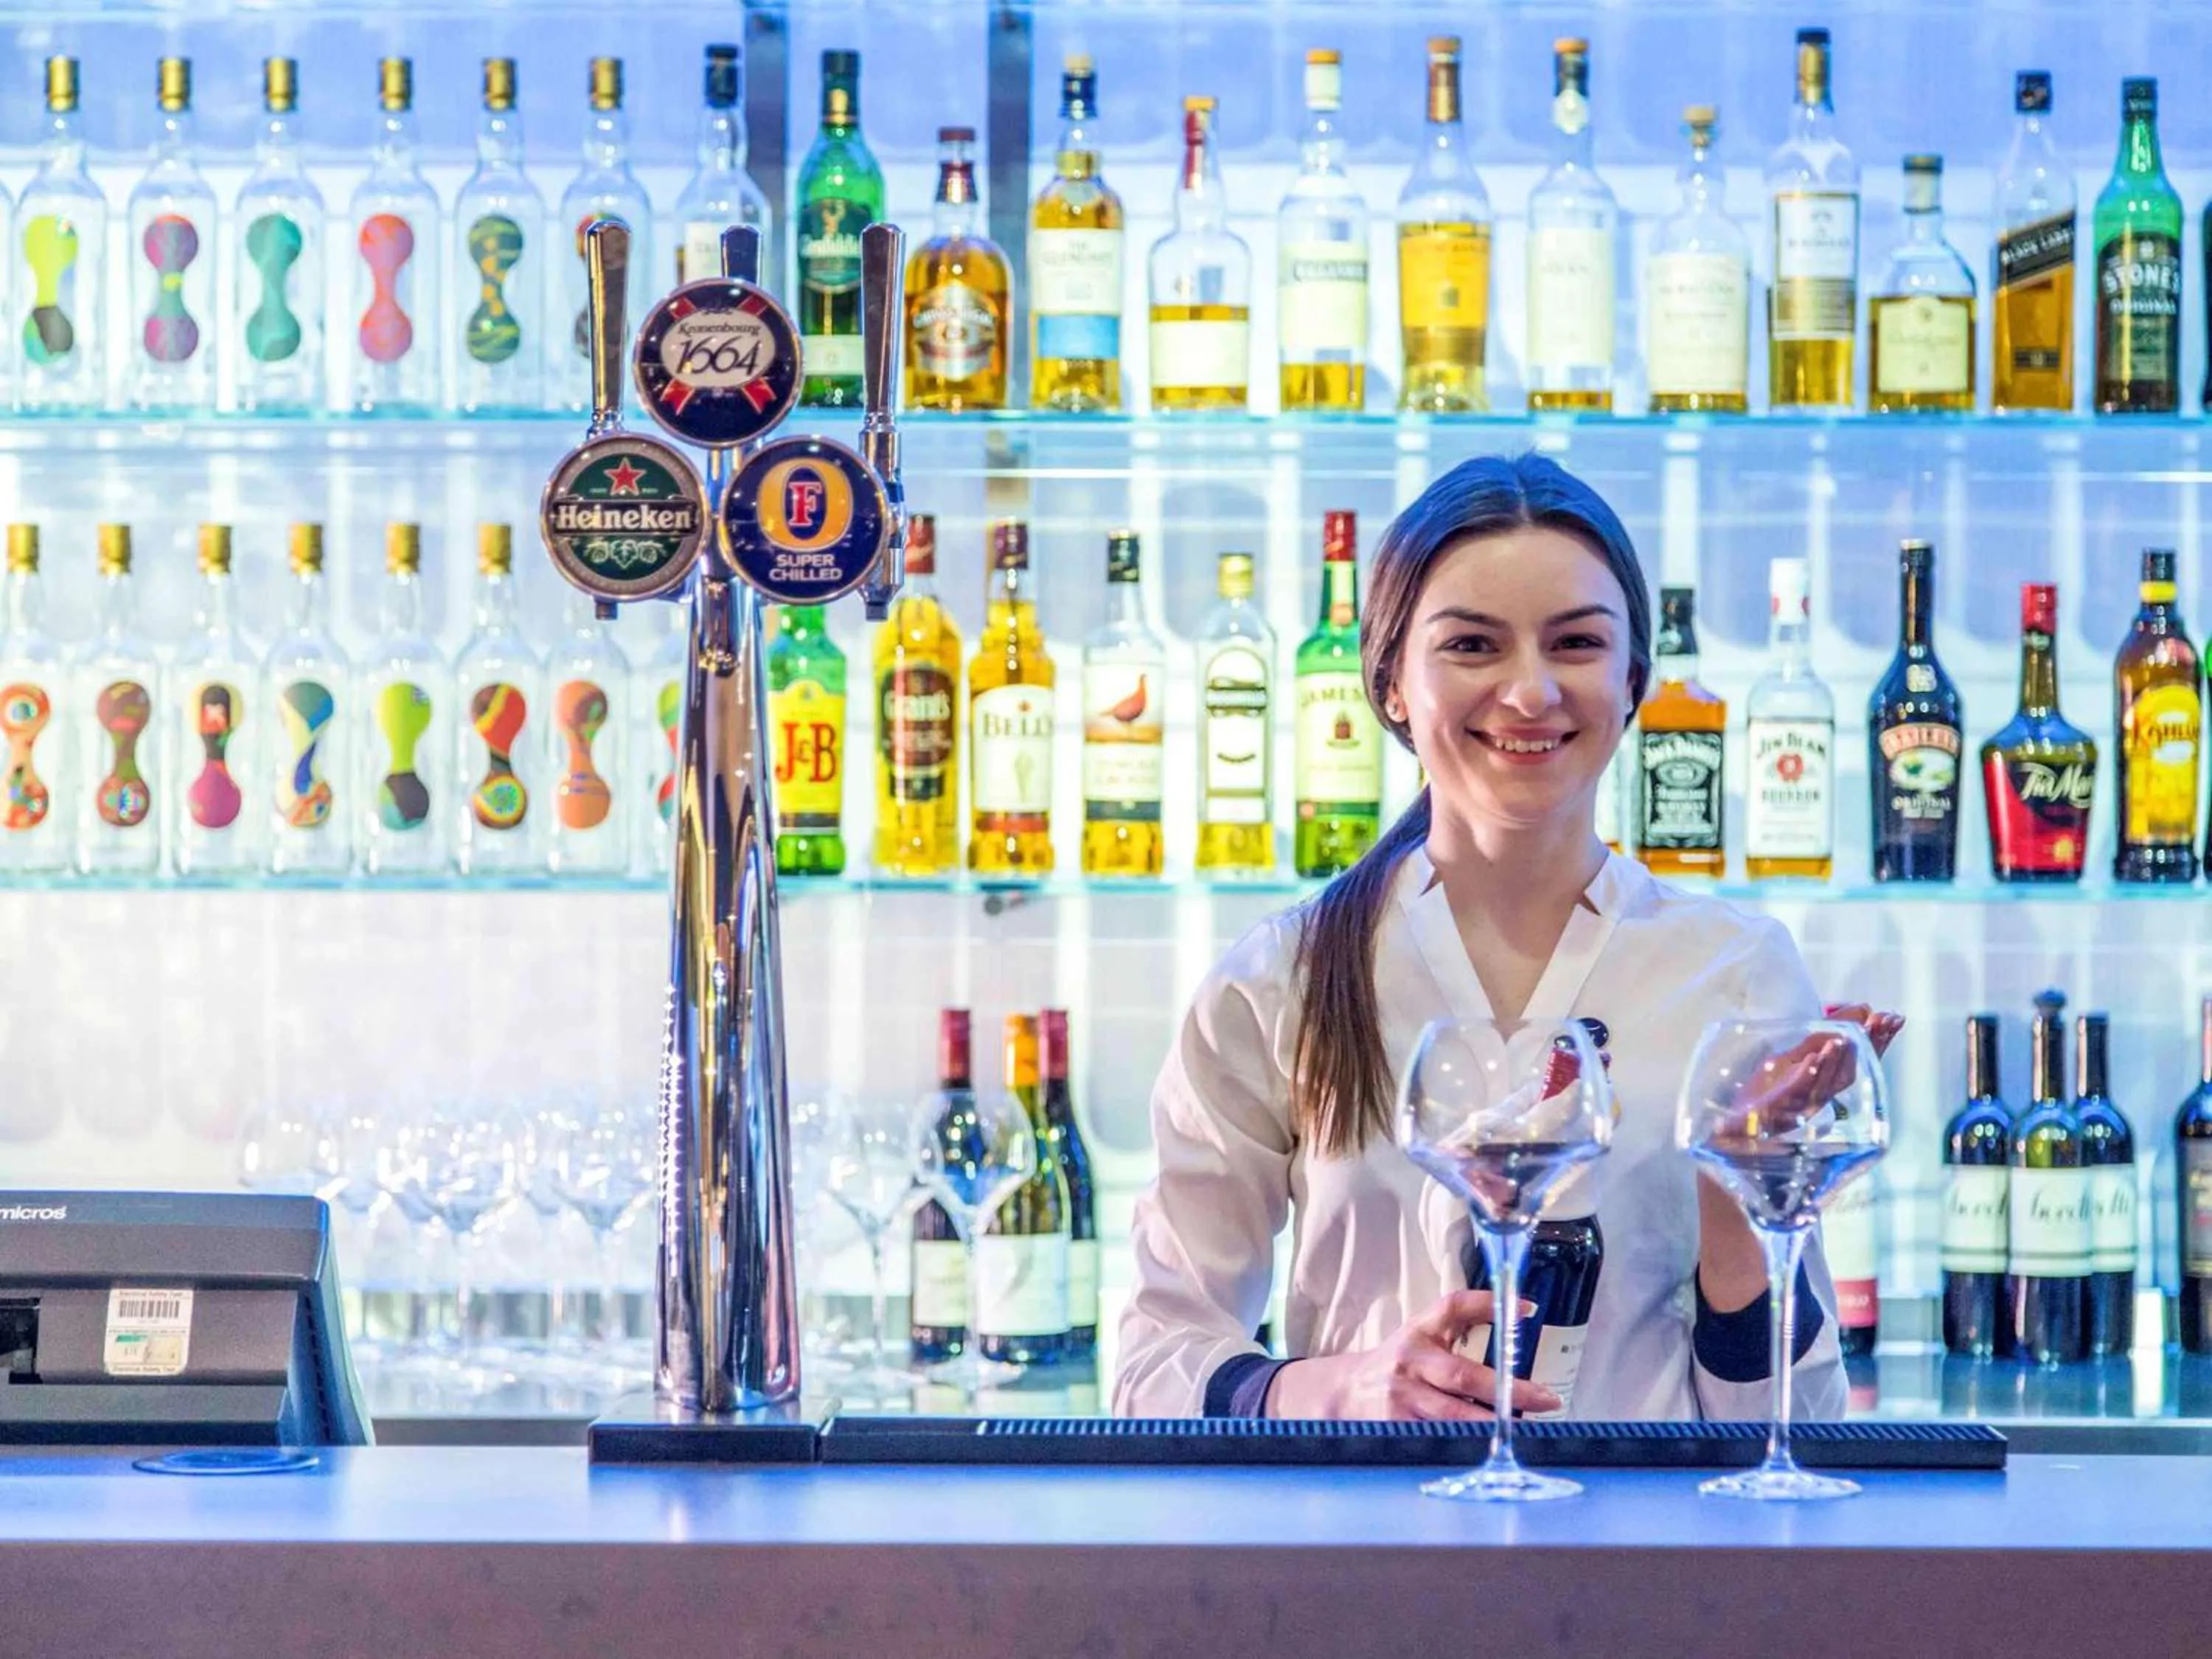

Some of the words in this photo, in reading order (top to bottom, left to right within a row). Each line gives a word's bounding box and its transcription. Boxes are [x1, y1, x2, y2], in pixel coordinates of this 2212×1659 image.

[676, 322, 762, 337] Kronenbourg
[675, 335, 762, 375] 1664
[556, 504, 691, 530] Heineken
[776, 554, 835, 567] SUPER
[768, 567, 843, 582] CHILLED
